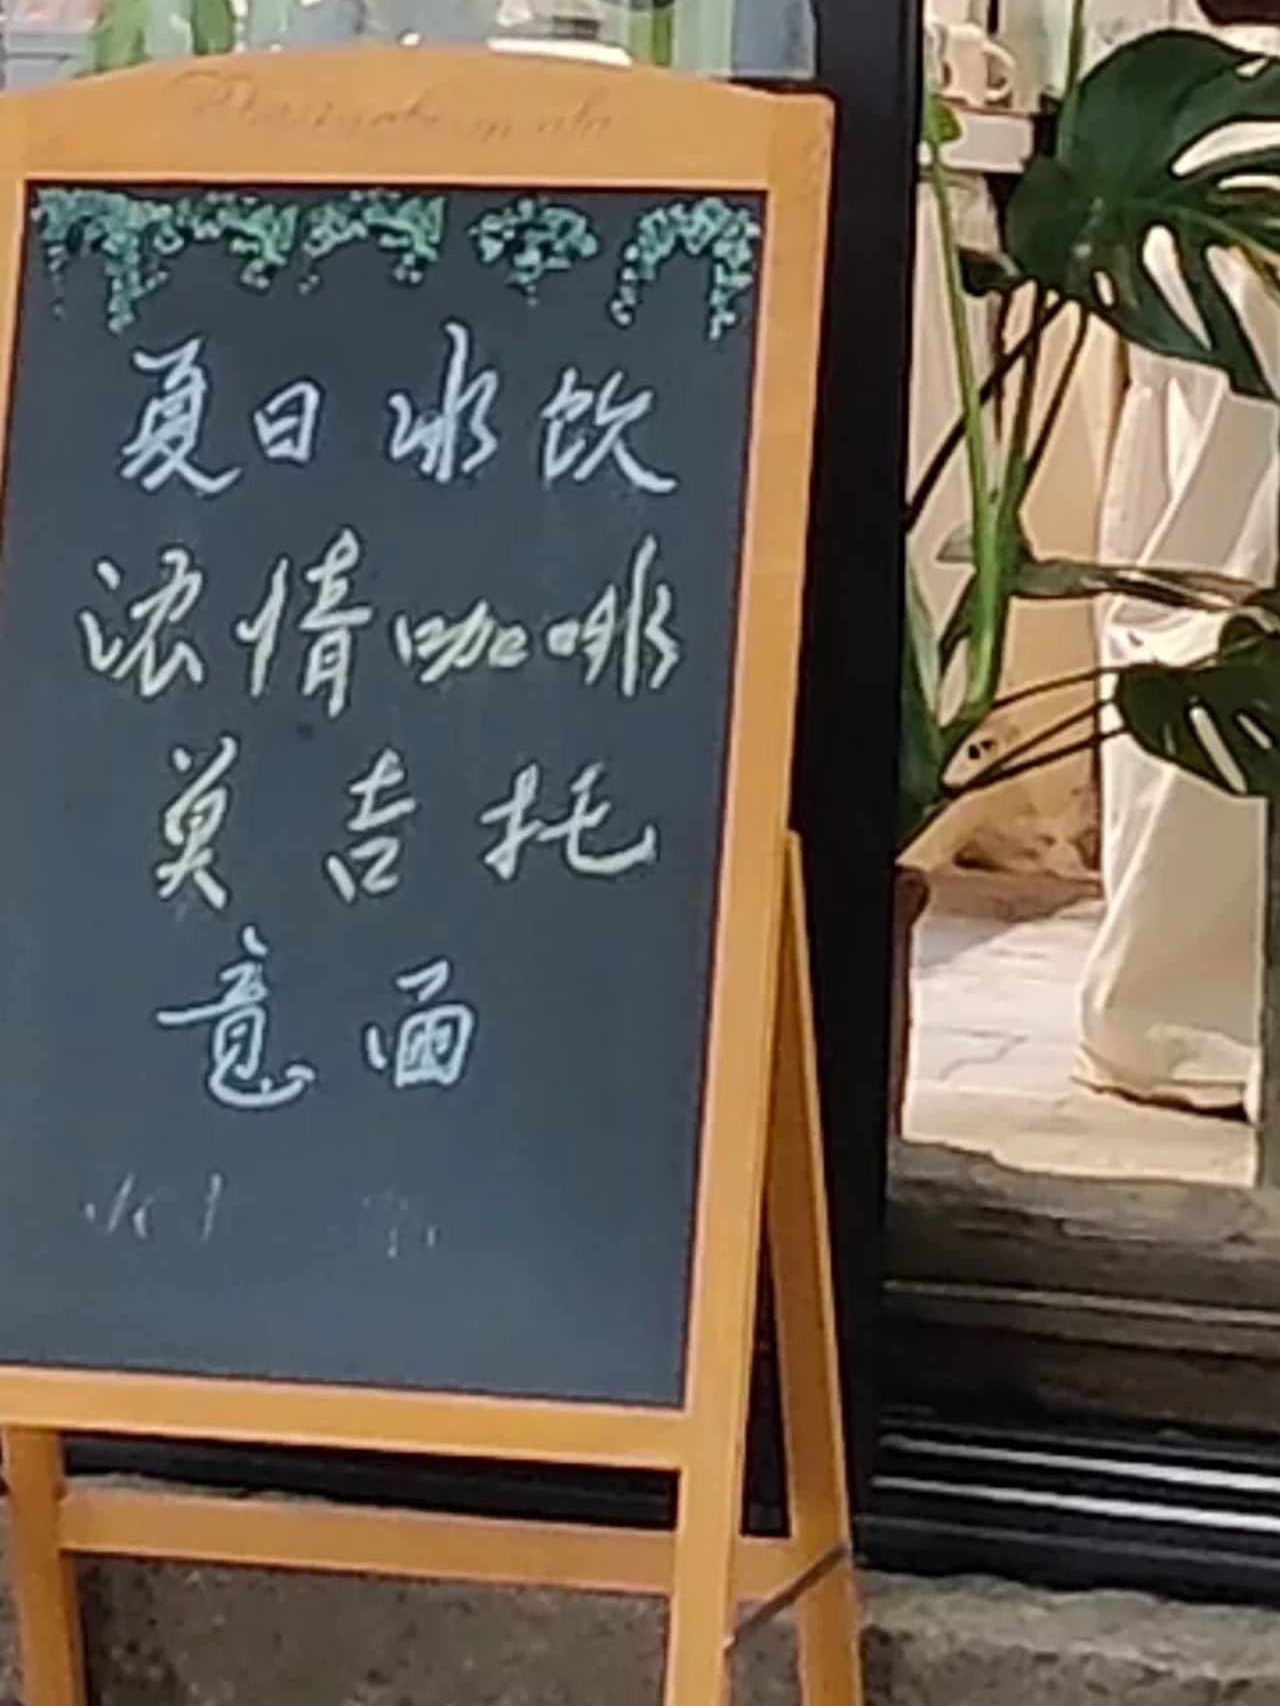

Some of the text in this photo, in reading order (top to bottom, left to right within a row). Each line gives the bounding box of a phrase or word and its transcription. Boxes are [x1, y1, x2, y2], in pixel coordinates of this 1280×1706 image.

[81, 528, 686, 718] 浓情咖啡
[155, 736, 661, 910] 莫吉托
[156, 926, 476, 1109] 意面
